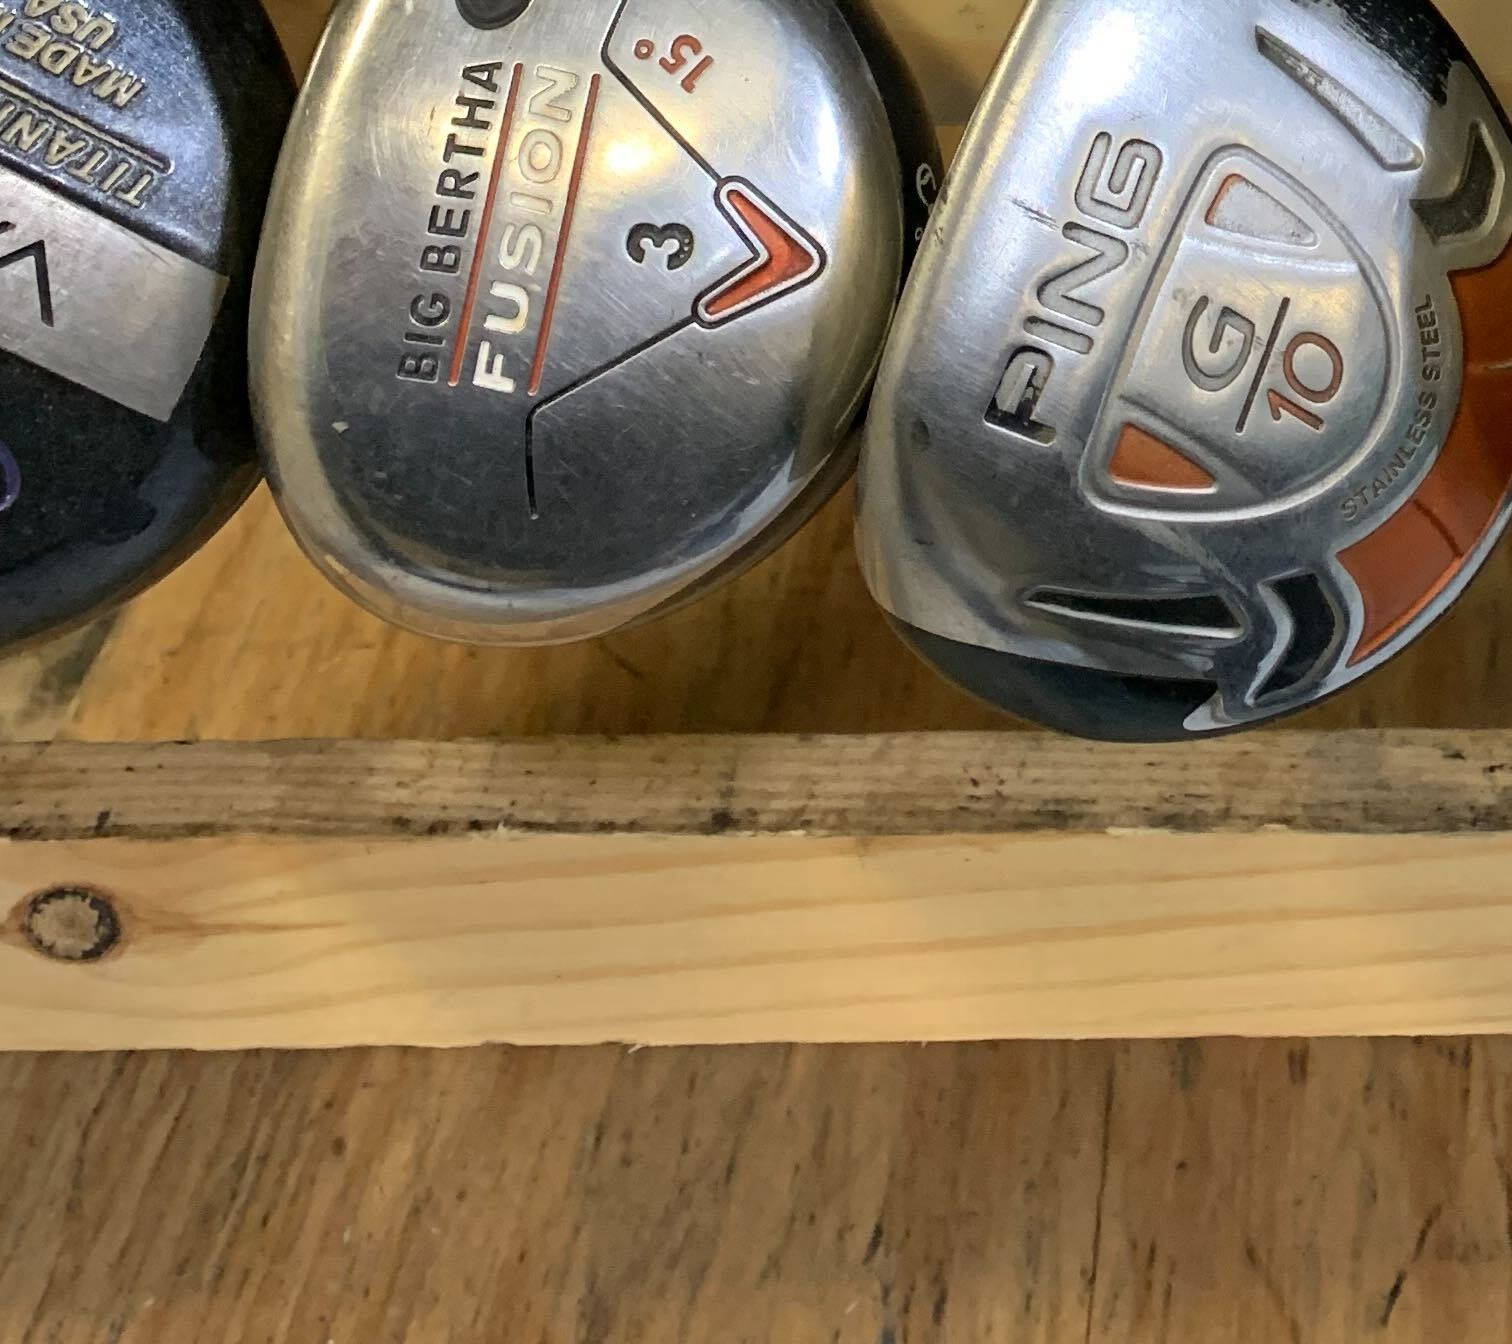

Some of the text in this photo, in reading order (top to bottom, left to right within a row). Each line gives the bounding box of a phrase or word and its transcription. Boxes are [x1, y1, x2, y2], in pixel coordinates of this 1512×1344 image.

[3, 20, 146, 109] MADE
[399, 59, 504, 384] BIG BERTHA
[472, 63, 580, 396] FUSION
[626, 221, 696, 271] 3
[984, 131, 1165, 446] PING
[1268, 331, 1345, 431] 10
[1339, 293, 1443, 524] STAINLESS STEEL
